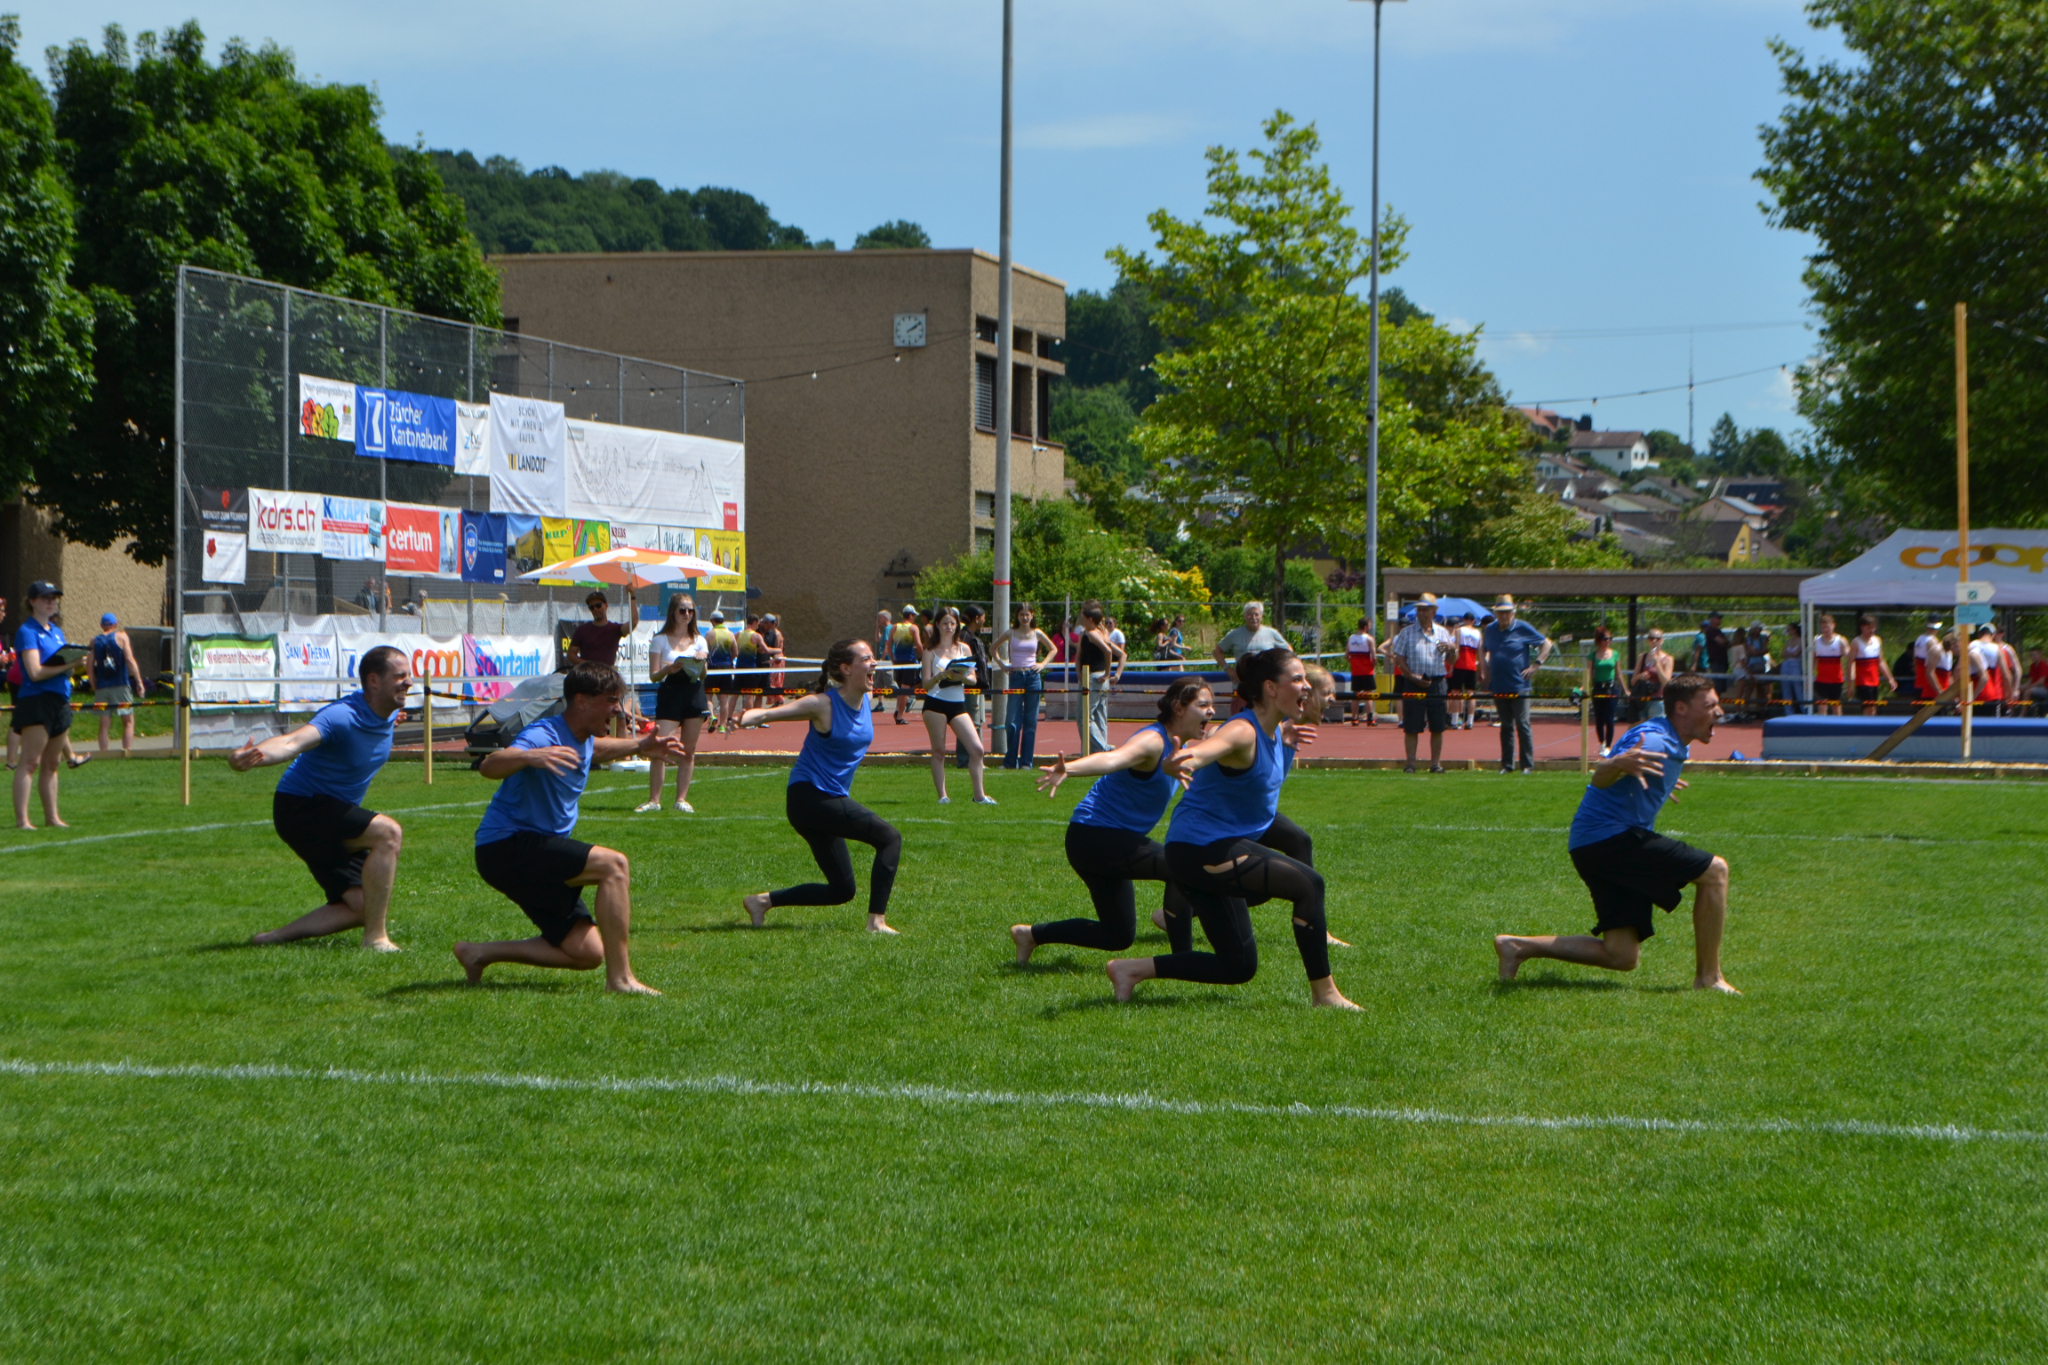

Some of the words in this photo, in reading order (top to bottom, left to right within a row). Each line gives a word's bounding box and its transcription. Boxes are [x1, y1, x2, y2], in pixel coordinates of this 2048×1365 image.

[389, 400, 423, 426] Zürcher
[390, 424, 448, 452] Kantonalbank
[517, 453, 547, 473] LANDOLT
[257, 497, 316, 532] kdrs.ch
[389, 525, 433, 553] certum
[611, 526, 627, 539] KREBS
[306, 643, 332, 660] THERM
[475, 646, 541, 677] Sportamt
[412, 649, 462, 694] coop
